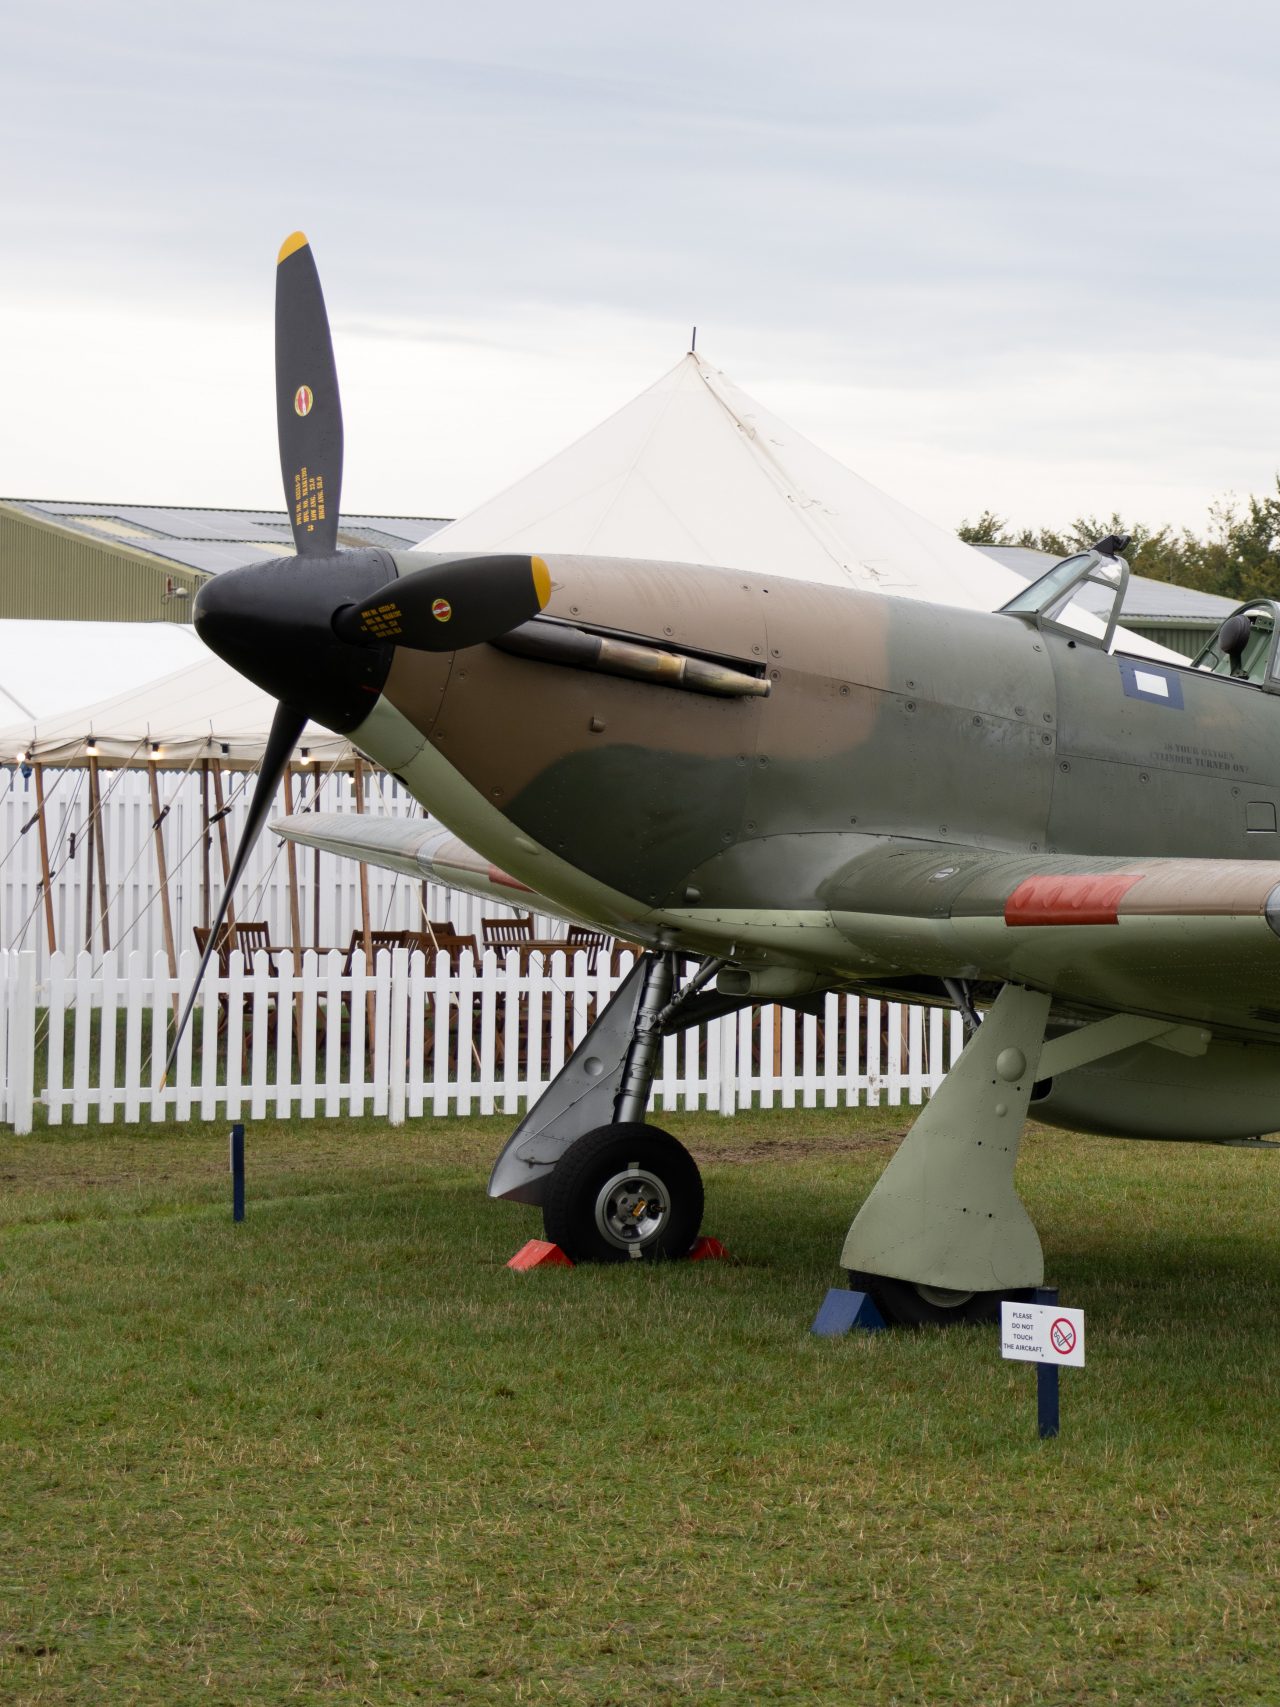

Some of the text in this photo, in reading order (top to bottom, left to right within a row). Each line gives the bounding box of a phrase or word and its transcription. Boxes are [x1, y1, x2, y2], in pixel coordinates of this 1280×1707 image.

[1175, 743, 1199, 755] YOUR
[1201, 748, 1235, 760] OXYGEN
[1149, 751, 1192, 765] CYLINDER
[1195, 758, 1231, 771] TURNED
[1016, 1344, 1042, 1352] AIRCRAFT
